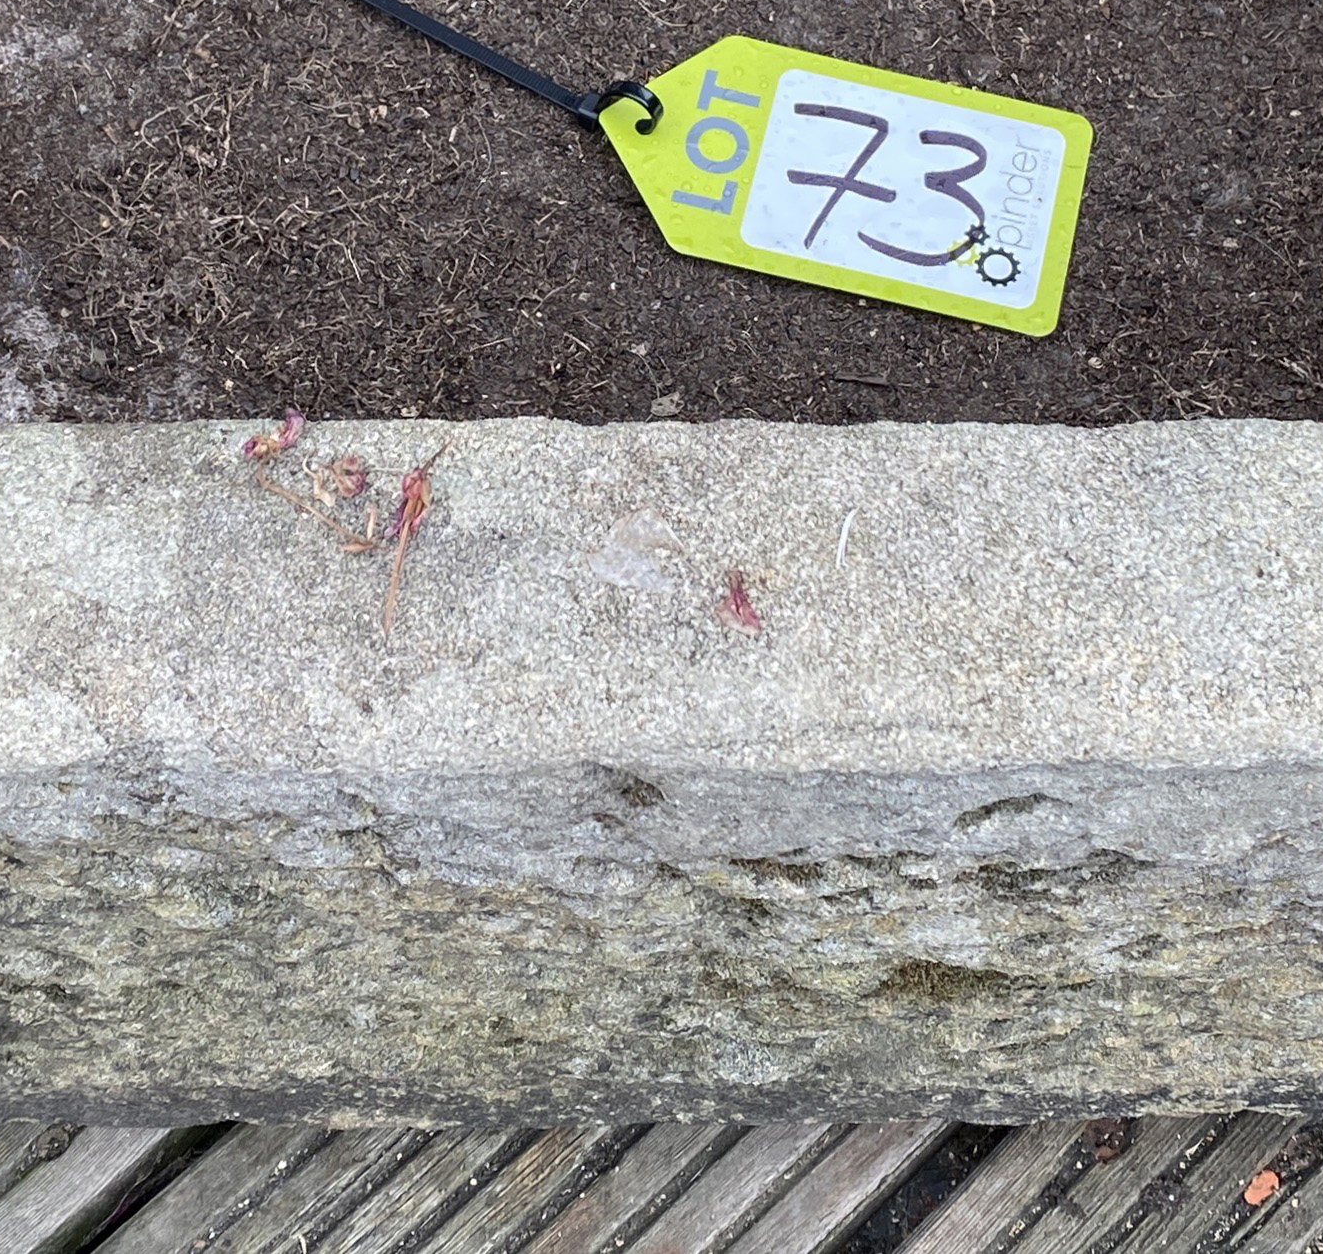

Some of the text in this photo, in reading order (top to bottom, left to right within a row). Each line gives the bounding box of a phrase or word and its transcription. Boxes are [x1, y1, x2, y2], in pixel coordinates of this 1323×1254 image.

[671, 69, 761, 216] LOT
[786, 102, 988, 267] 73
[990, 133, 1040, 251] pinder
